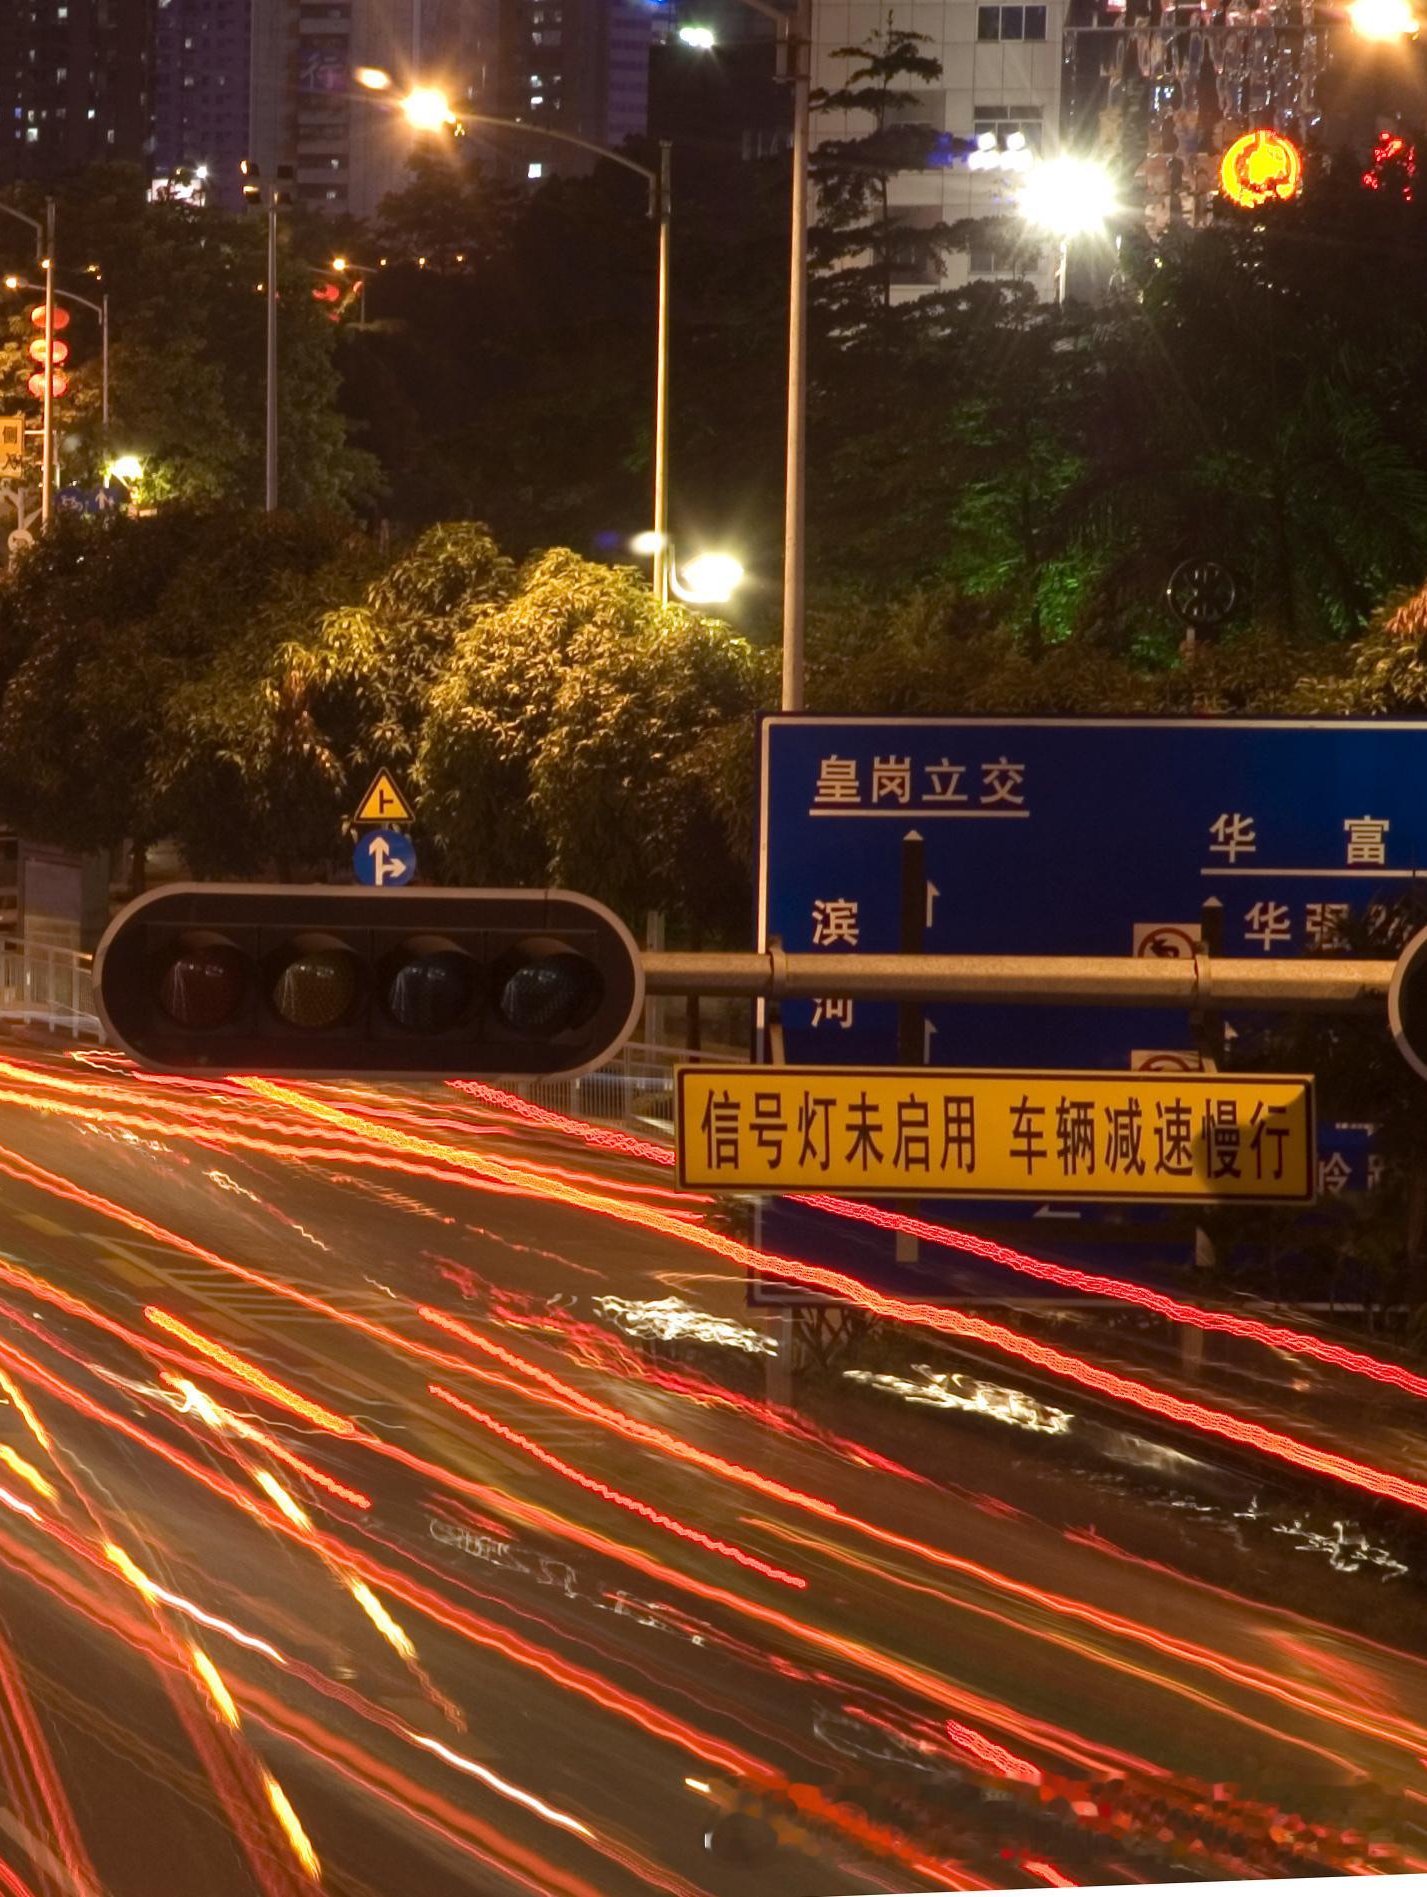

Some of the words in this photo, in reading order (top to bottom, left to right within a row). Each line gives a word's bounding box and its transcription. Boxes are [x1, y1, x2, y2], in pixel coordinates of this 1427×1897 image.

[814, 754, 1025, 804] 皇岗立交
[1209, 813, 1390, 865] 华富
[701, 1088, 976, 1173] 信号灯未启用
[1009, 1095, 1290, 1180] 车辆减速慢行
